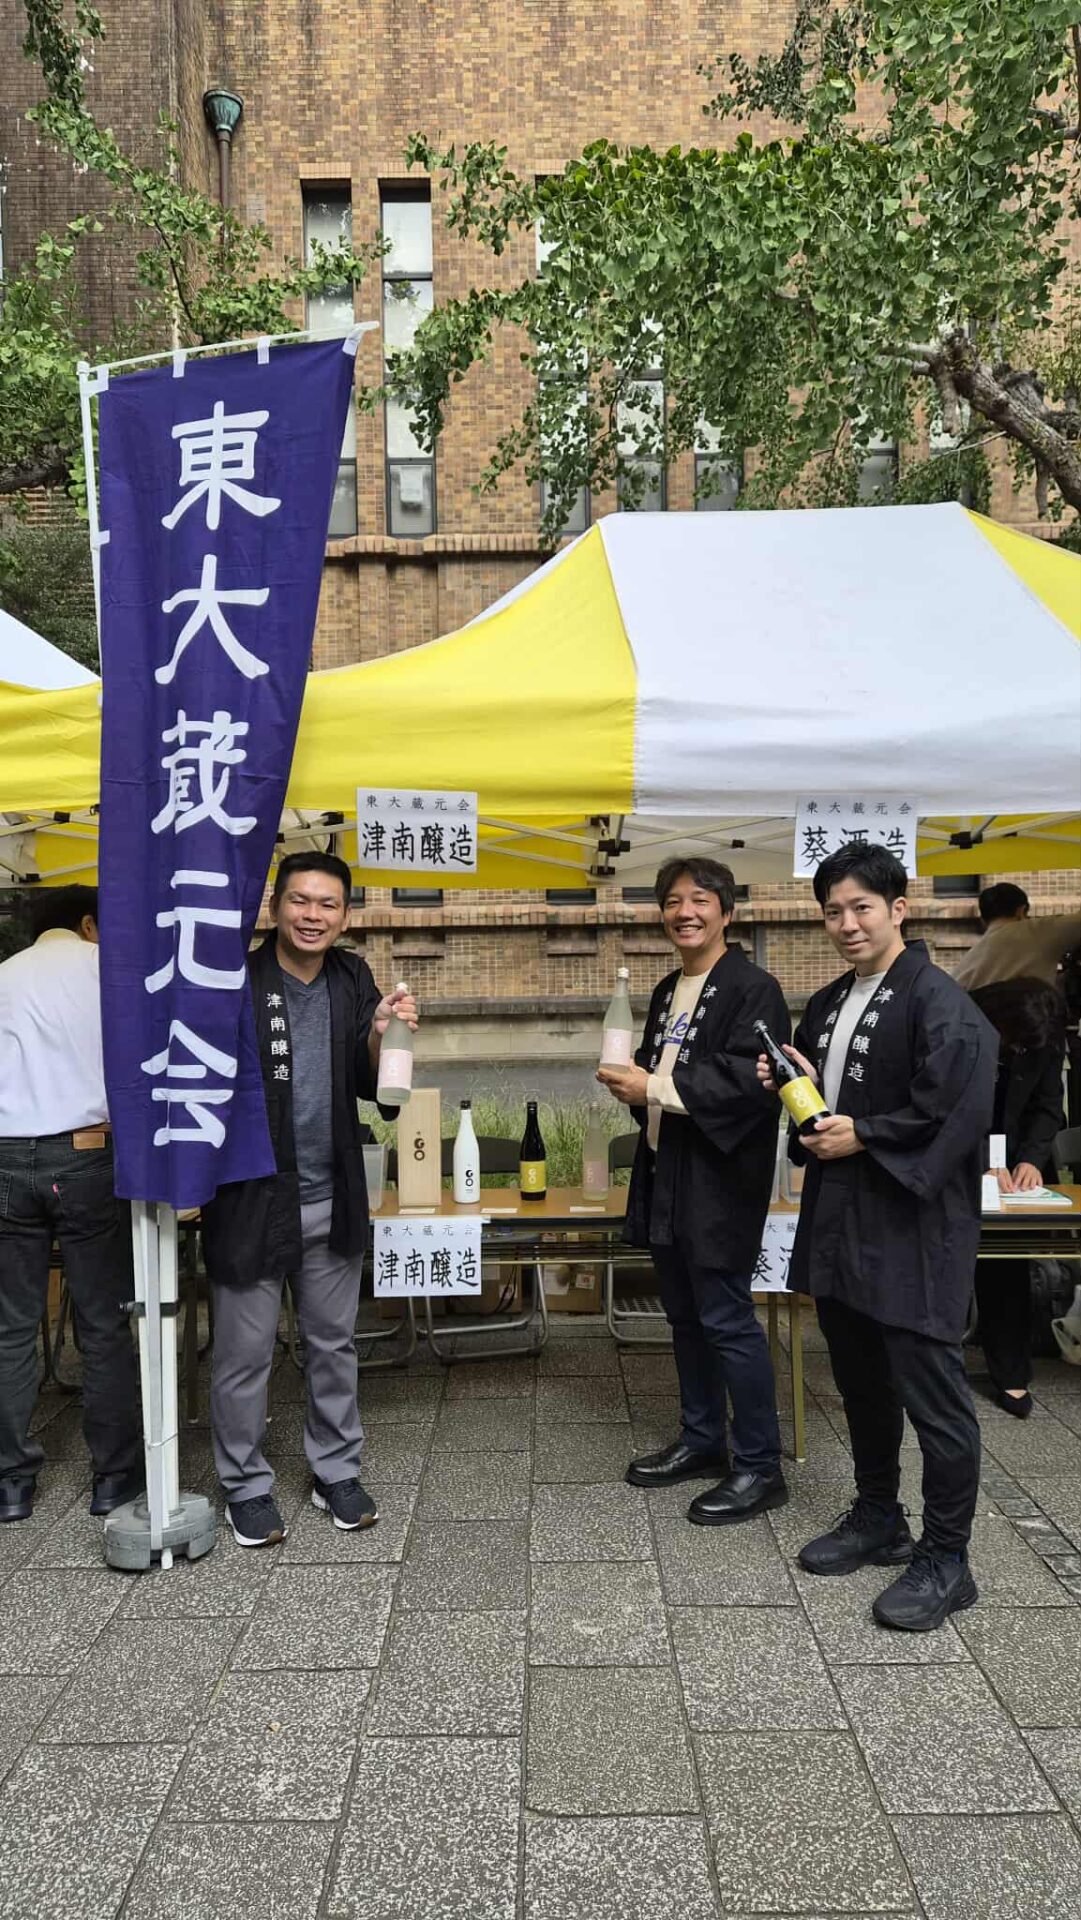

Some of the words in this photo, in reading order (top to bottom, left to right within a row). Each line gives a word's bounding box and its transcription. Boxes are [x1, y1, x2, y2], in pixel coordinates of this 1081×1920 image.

[140, 400, 282, 1148] 東大蔵元会
[366, 794, 470, 811] 東大蔵元会
[806, 801, 912, 815] 東大蔵元会
[362, 820, 475, 866] 津南醸造
[266, 993, 291, 1081] 津南醸造
[847, 986, 895, 1082] 津南醸造
[378, 1247, 479, 1288] 津南醸造
